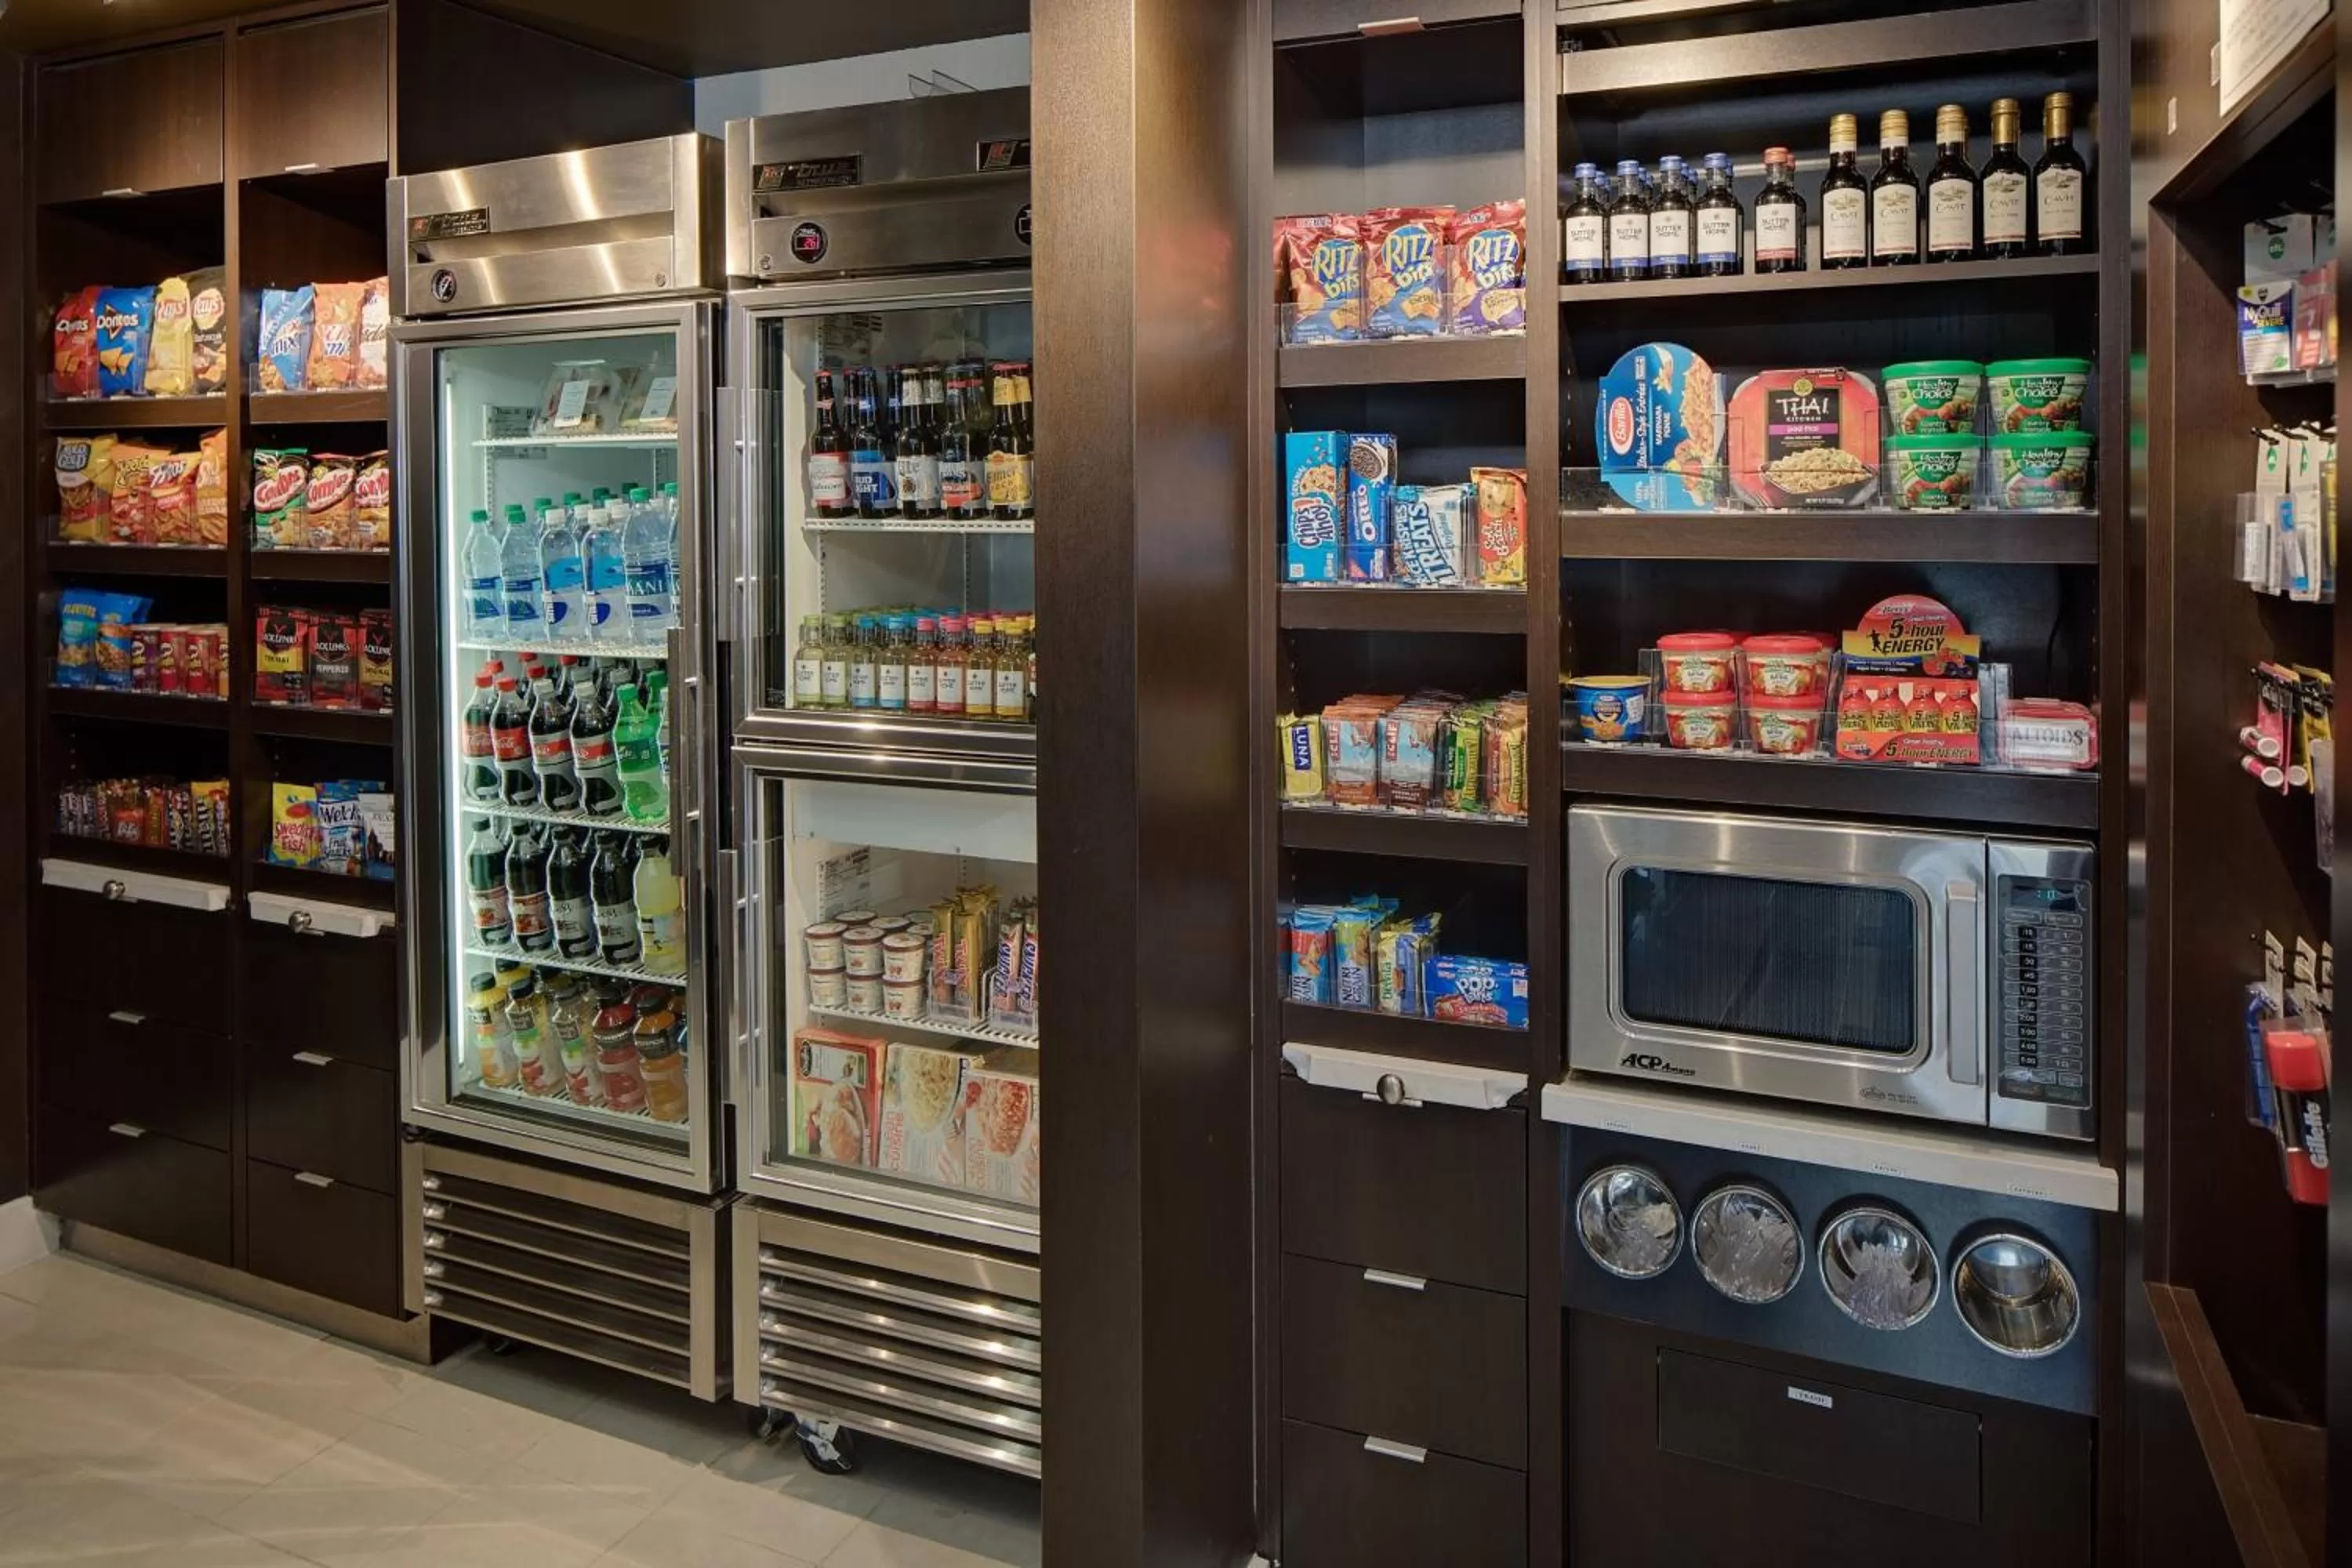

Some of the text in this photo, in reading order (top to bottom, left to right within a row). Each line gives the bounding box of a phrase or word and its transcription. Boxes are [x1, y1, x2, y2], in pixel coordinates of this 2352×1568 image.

[1382, 230, 1438, 273] RITZ
[1467, 234, 1517, 273] RITZ
[1394, 261, 1436, 289] bits
[1476, 261, 1515, 289] bits
[96, 313, 139, 329] Doritos
[1614, 400, 1627, 441] Barilla
[1775, 397, 1828, 416] THAI
[1663, 412, 1671, 438] PENNE
[1357, 484, 1377, 542] OREO
[1408, 502, 1456, 583] TREATS
[1889, 617, 1945, 639] 5-hour
[1882, 637, 1945, 655] ENERGY
[1294, 726, 1311, 768] LUNA
[2009, 726, 2084, 746] ALTOIDS
[281, 833, 306, 855] Fish
[1341, 967, 1351, 1001] NUTRI
[1620, 1053, 1663, 1070] ACP
[2303, 1099, 2329, 1169] Gillette
